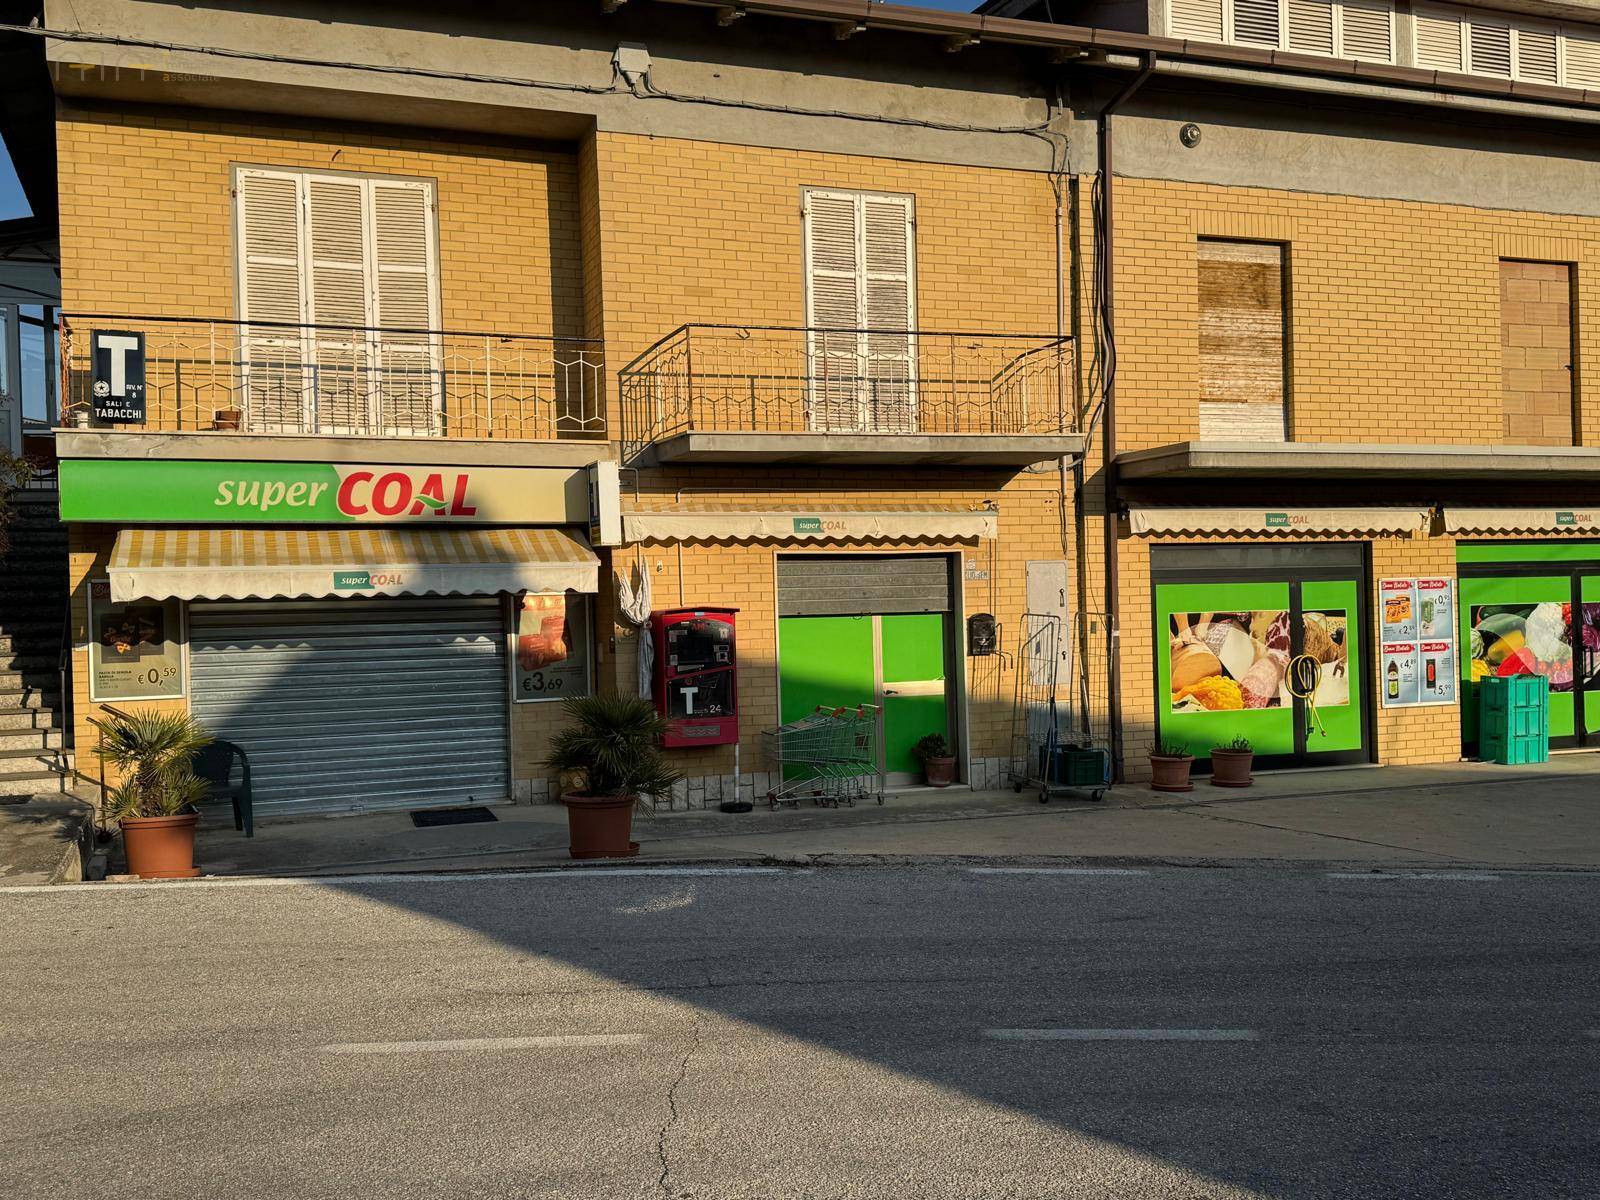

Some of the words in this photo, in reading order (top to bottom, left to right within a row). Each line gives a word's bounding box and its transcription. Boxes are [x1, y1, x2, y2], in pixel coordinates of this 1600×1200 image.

[98, 335, 138, 396] T
[95, 408, 142, 419] TABACCHI
[214, 480, 329, 512] super
[336, 472, 476, 516] COAL
[822, 520, 847, 530] COAL
[1288, 515, 1310, 524] COAL
[340, 576, 368, 586] super
[370, 574, 404, 586] COAL
[680, 687, 698, 714] T
